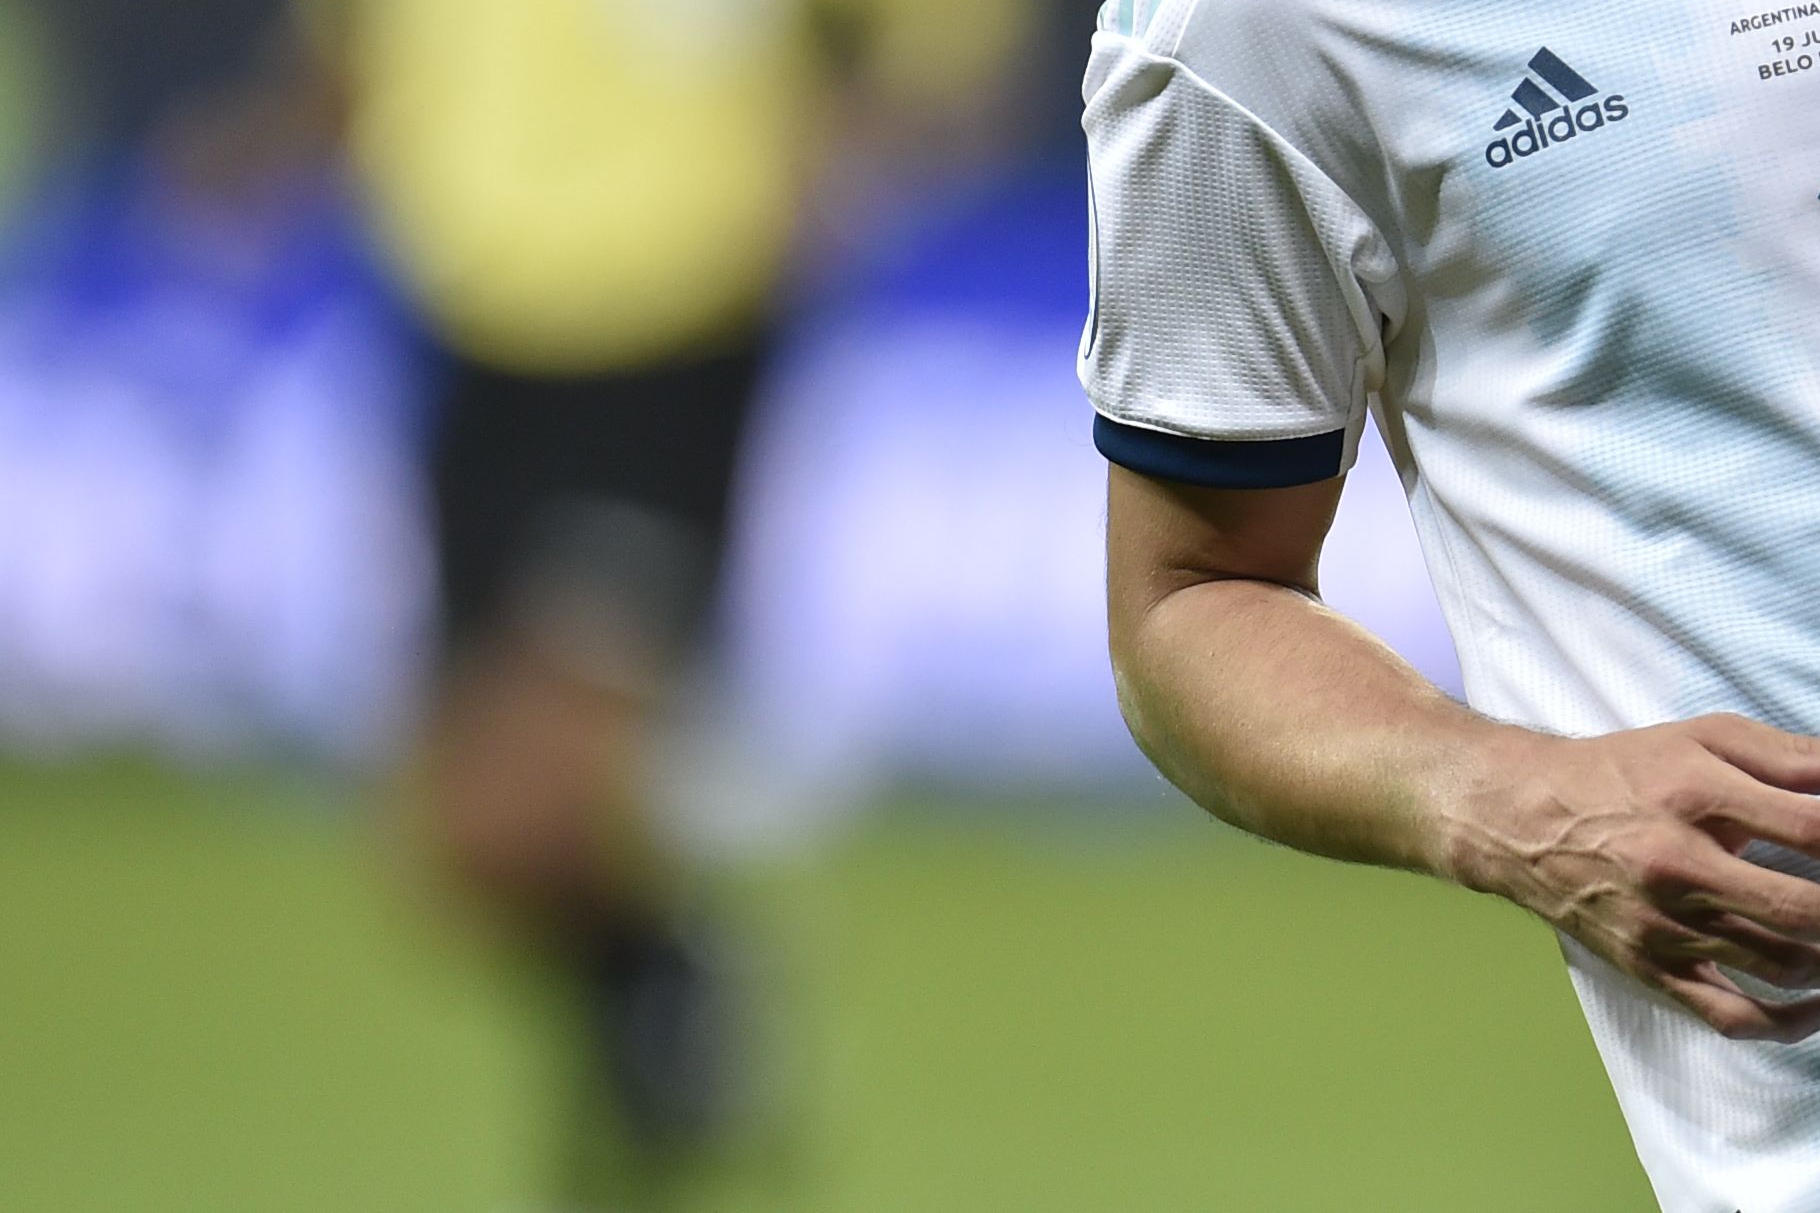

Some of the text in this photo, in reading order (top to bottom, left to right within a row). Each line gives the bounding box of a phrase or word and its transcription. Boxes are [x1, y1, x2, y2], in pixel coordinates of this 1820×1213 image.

[1730, 2, 1820, 35] ARGENTINA
[1771, 36, 1795, 53] 19
[1757, 54, 1813, 80] BELO
[1485, 94, 1629, 168] adidas
